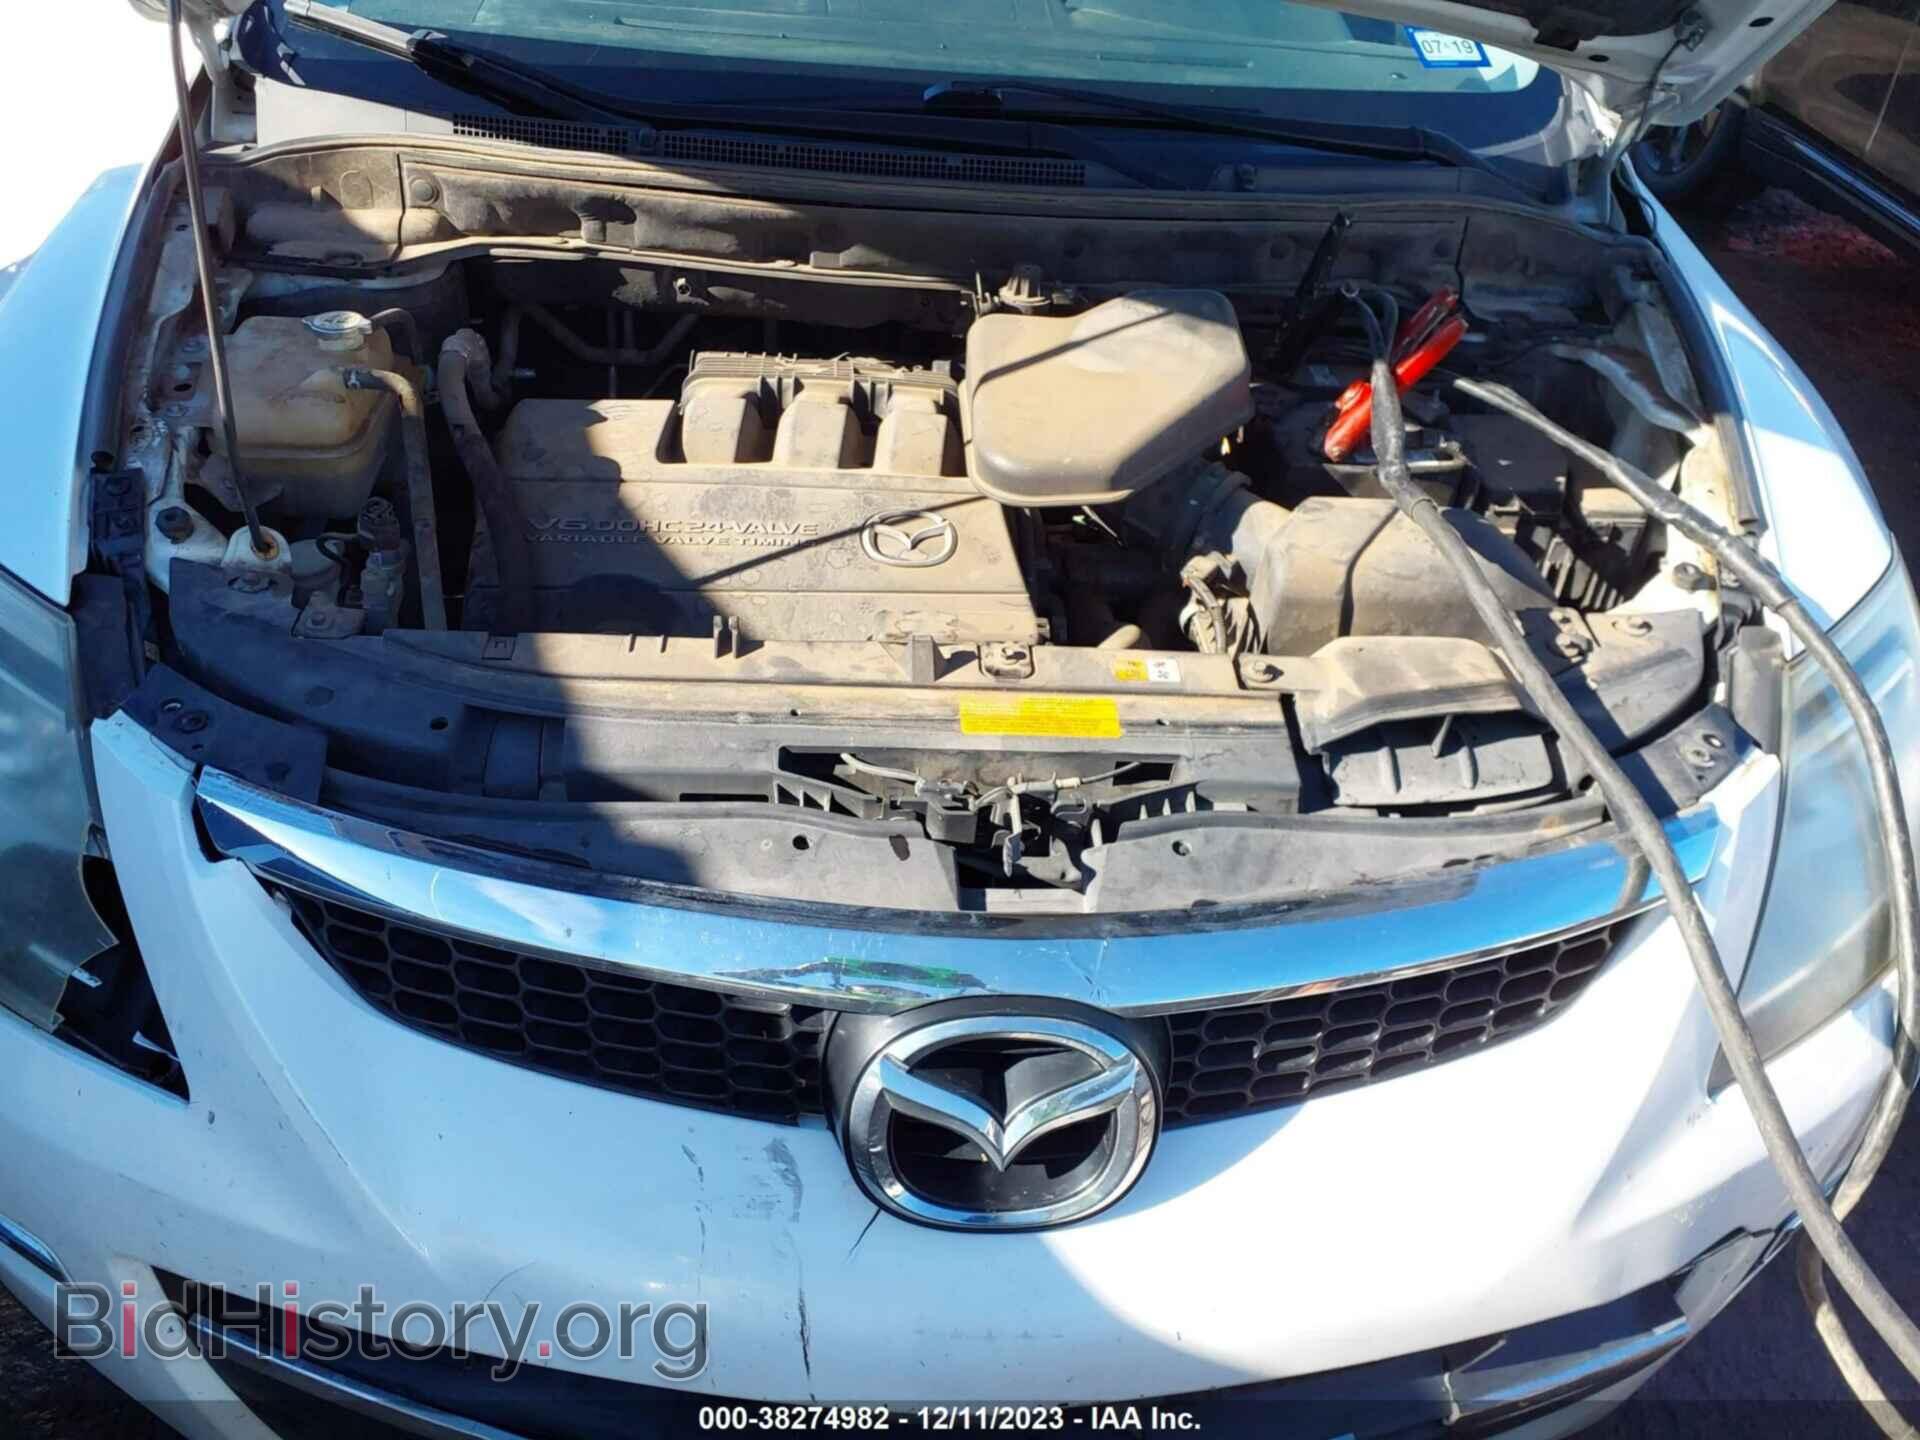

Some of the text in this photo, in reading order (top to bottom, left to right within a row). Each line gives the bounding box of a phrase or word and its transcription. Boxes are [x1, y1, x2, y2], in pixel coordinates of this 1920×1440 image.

[528, 516, 588, 532] V6
[595, 518, 683, 533] DOHC
[655, 534, 731, 546] VALVE
